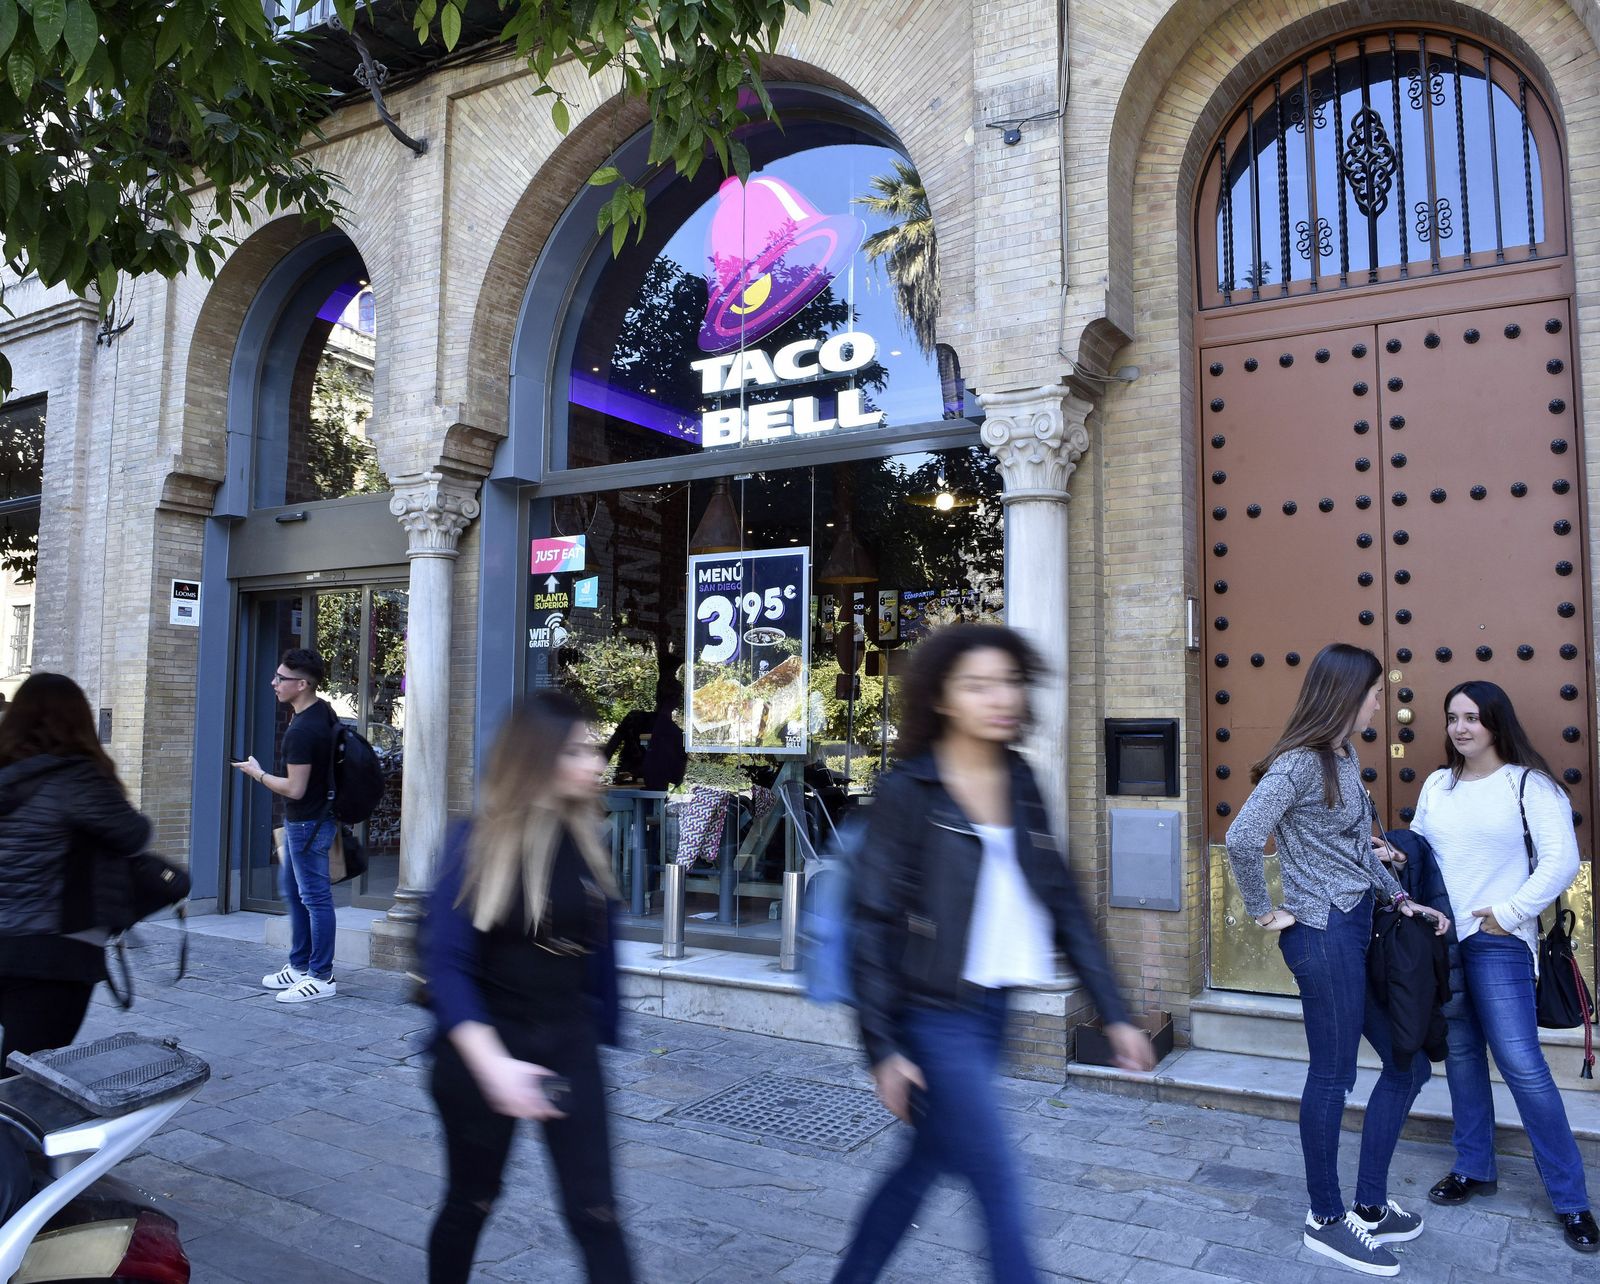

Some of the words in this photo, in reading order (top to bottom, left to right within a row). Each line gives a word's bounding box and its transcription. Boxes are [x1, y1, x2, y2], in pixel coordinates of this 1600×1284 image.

[690, 331, 876, 394] TACO
[702, 389, 884, 448] BELL
[535, 549, 561, 563] JUST
[561, 547, 581, 560] EAT
[698, 561, 744, 583] MENÚ
[699, 584, 716, 592] SAN
[717, 582, 742, 592] DIEGO
[535, 592, 569, 603] PLANTA
[535, 601, 569, 610] SUPERIOR
[529, 628, 550, 641] WIFI
[529, 639, 550, 648] GRATIS
